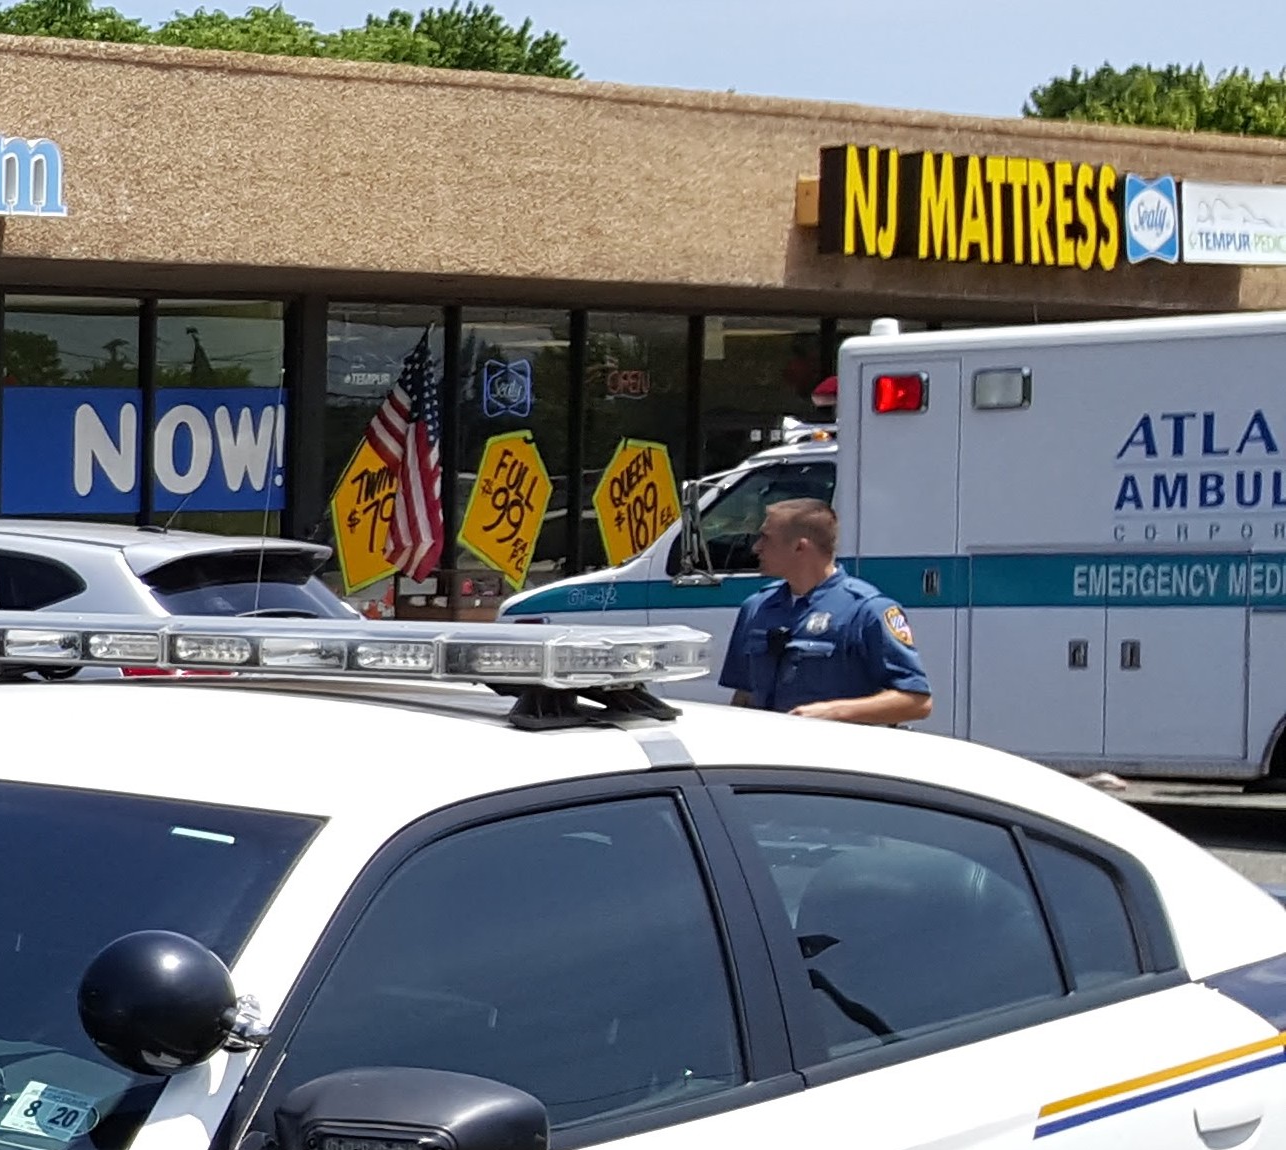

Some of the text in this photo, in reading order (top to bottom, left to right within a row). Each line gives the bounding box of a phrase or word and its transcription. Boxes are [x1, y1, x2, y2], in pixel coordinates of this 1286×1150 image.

[843, 143, 1120, 272] NJ MATTRESS
[1134, 199, 1168, 238] Sealy
[492, 376, 523, 402] Sealy
[73, 400, 286, 497] NOW!
[1116, 408, 1279, 459] ATLA
[494, 448, 539, 513] FULL
[610, 447, 654, 507] QUEEN
[1114, 470, 1286, 511] AMBUL
[1073, 563, 1220, 597] EMERGENCY
[24, 1099, 80, 1128] 8 20
